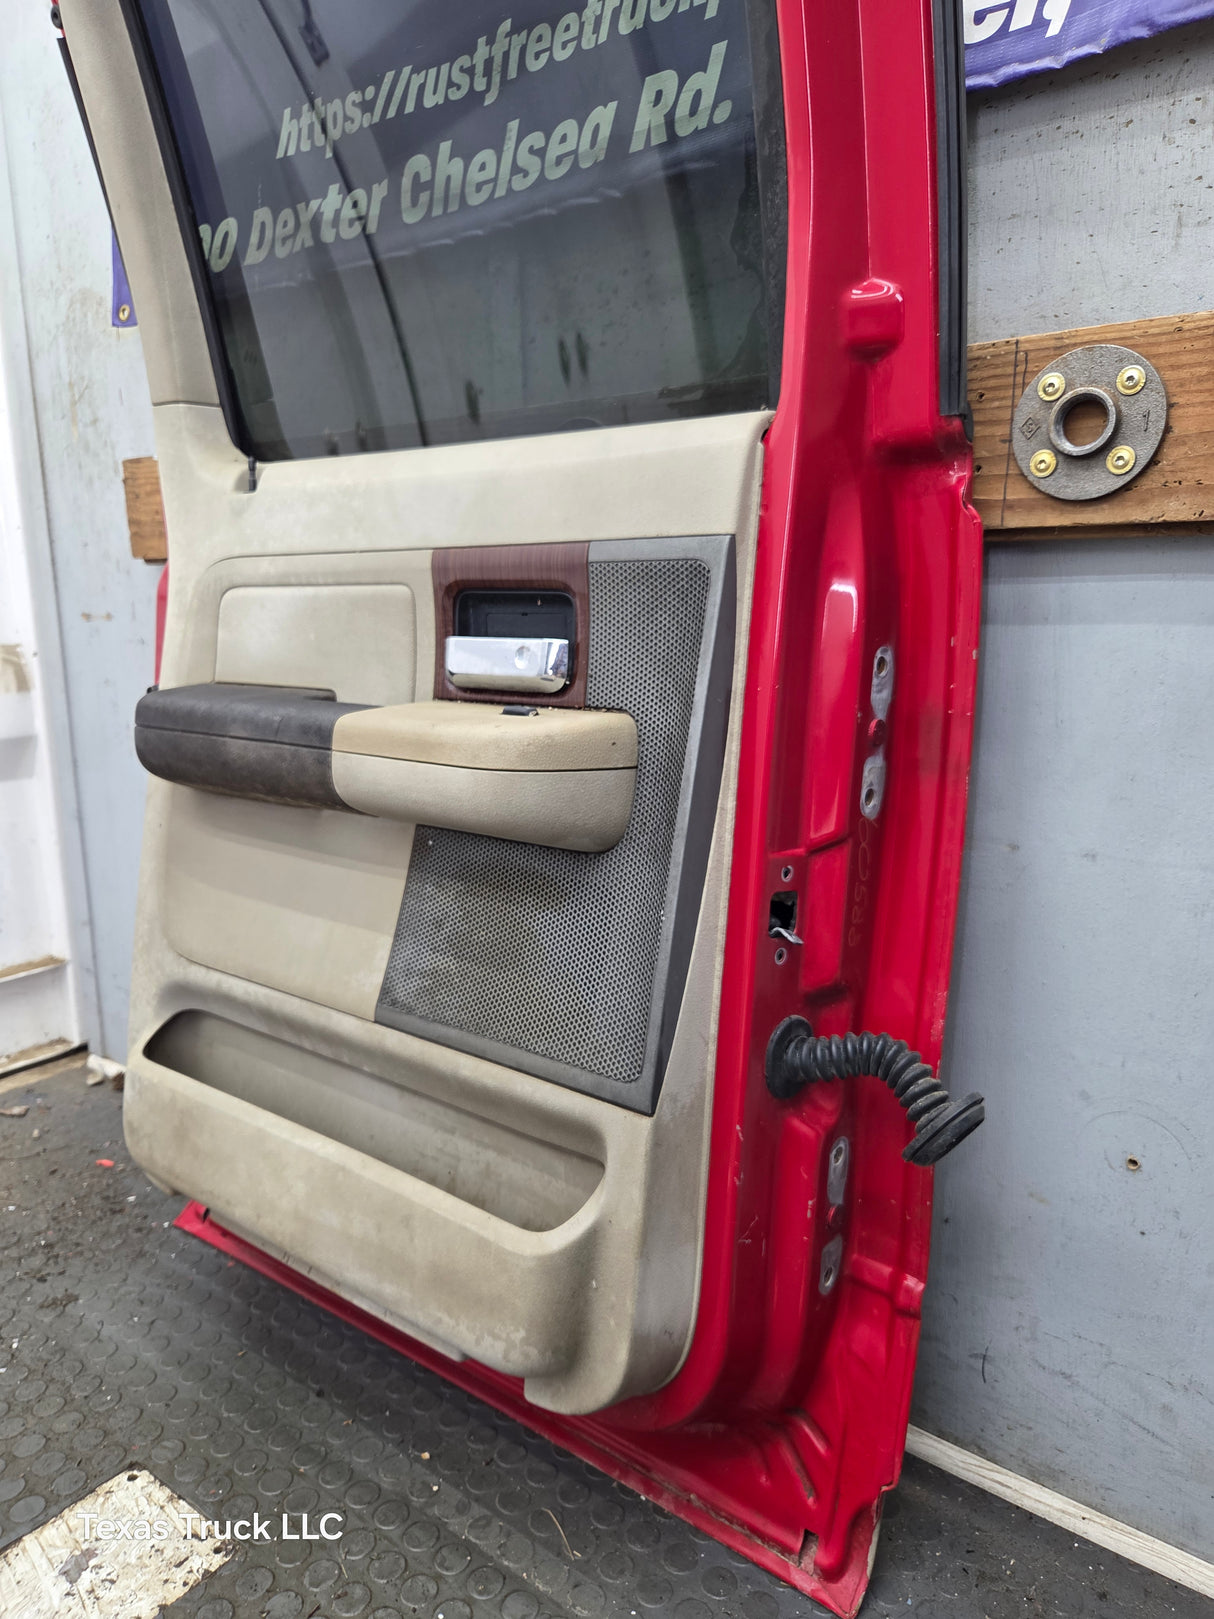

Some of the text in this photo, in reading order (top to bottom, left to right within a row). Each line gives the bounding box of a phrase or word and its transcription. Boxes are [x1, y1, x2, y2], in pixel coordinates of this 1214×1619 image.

[243, 178, 389, 266] Dexter
[400, 100, 619, 225] Chelsea
[628, 39, 733, 154] Rd.
[276, 0, 720, 160] https://rustfreetru
